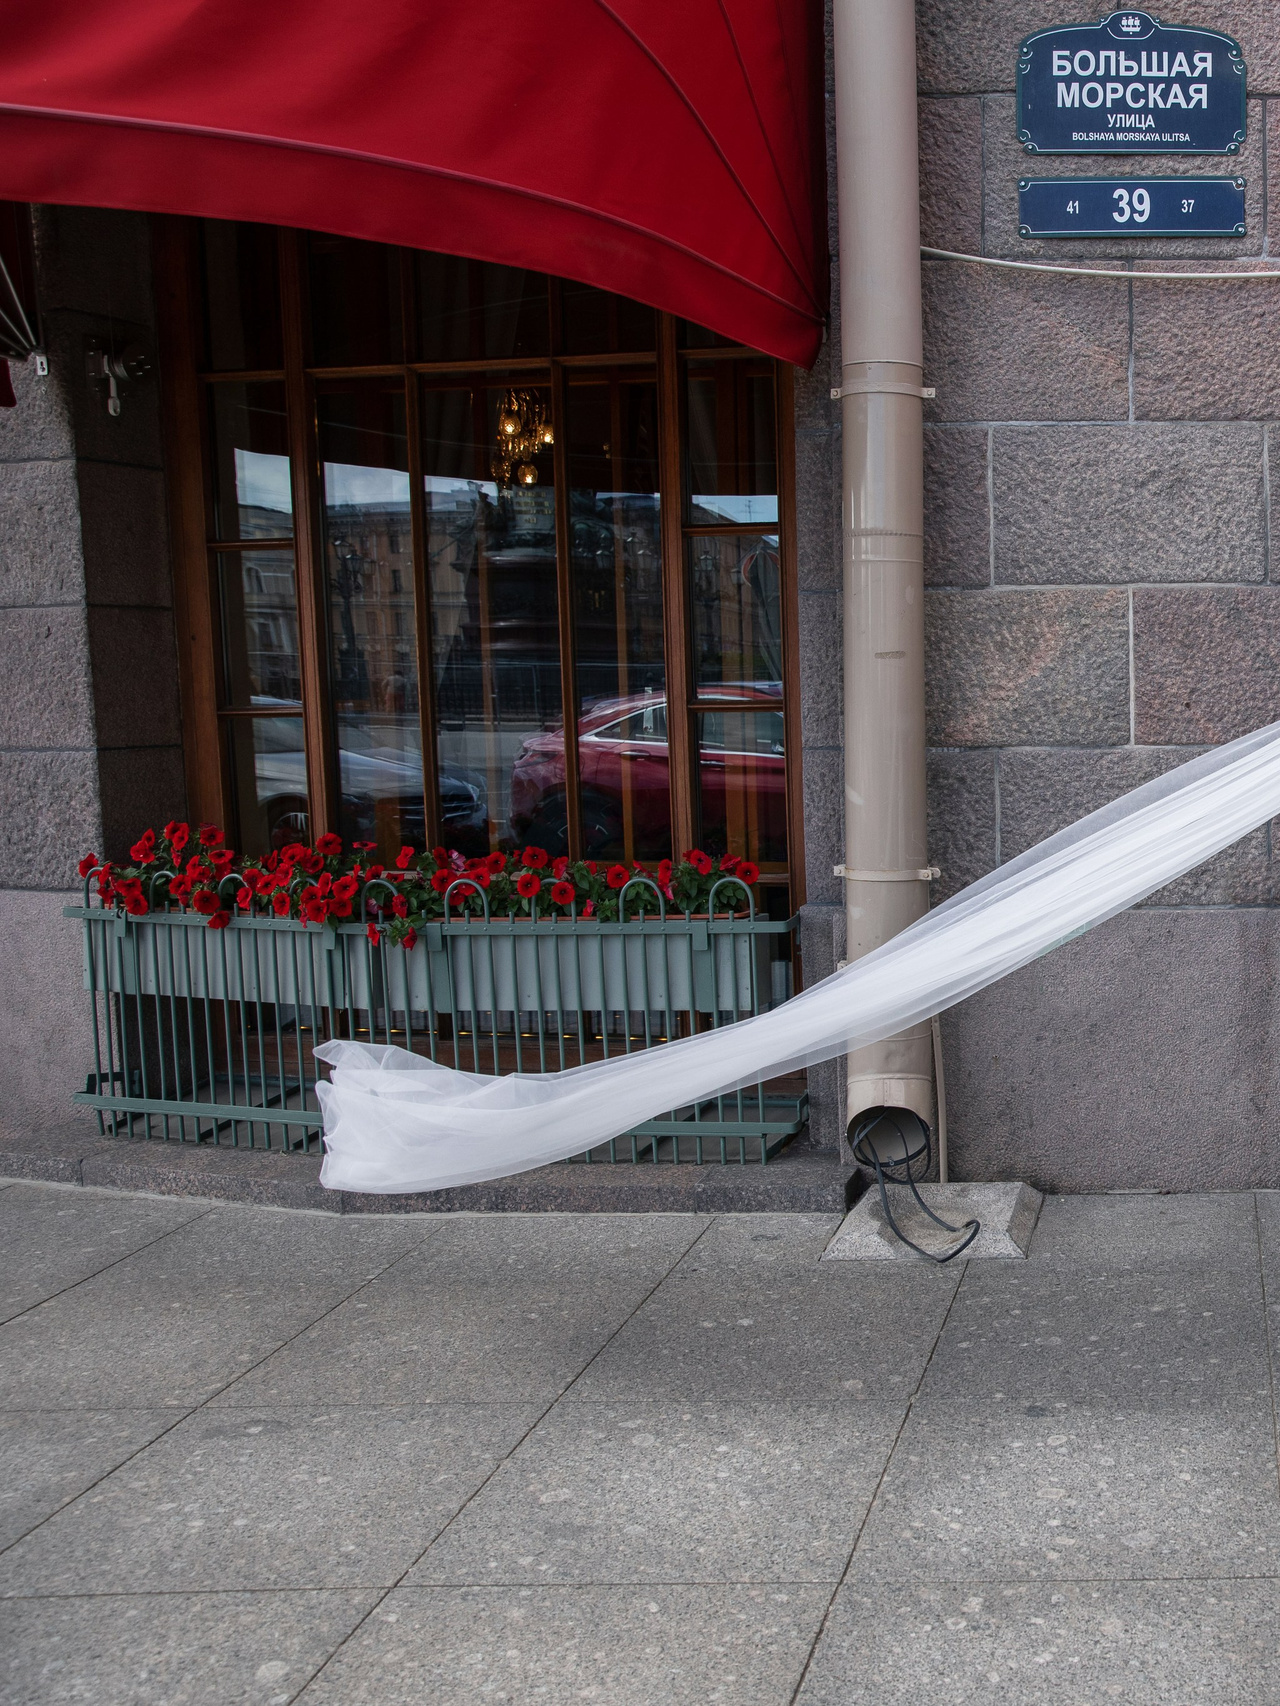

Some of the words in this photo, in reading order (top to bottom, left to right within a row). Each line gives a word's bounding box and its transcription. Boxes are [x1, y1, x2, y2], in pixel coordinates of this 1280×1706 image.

[1052, 49, 1213, 78] БОЛЬШАЯ
[1056, 82, 1208, 109] МОРСКАЯ
[1107, 114, 1156, 130] УЛИЦА
[1072, 132, 1115, 141] BOLSHAYA
[1116, 132, 1161, 142] MORSKAYA
[1161, 133, 1191, 142] ULITSA
[1066, 200, 1080, 214] 41
[1112, 188, 1151, 223] 39
[1181, 200, 1195, 213] 37
